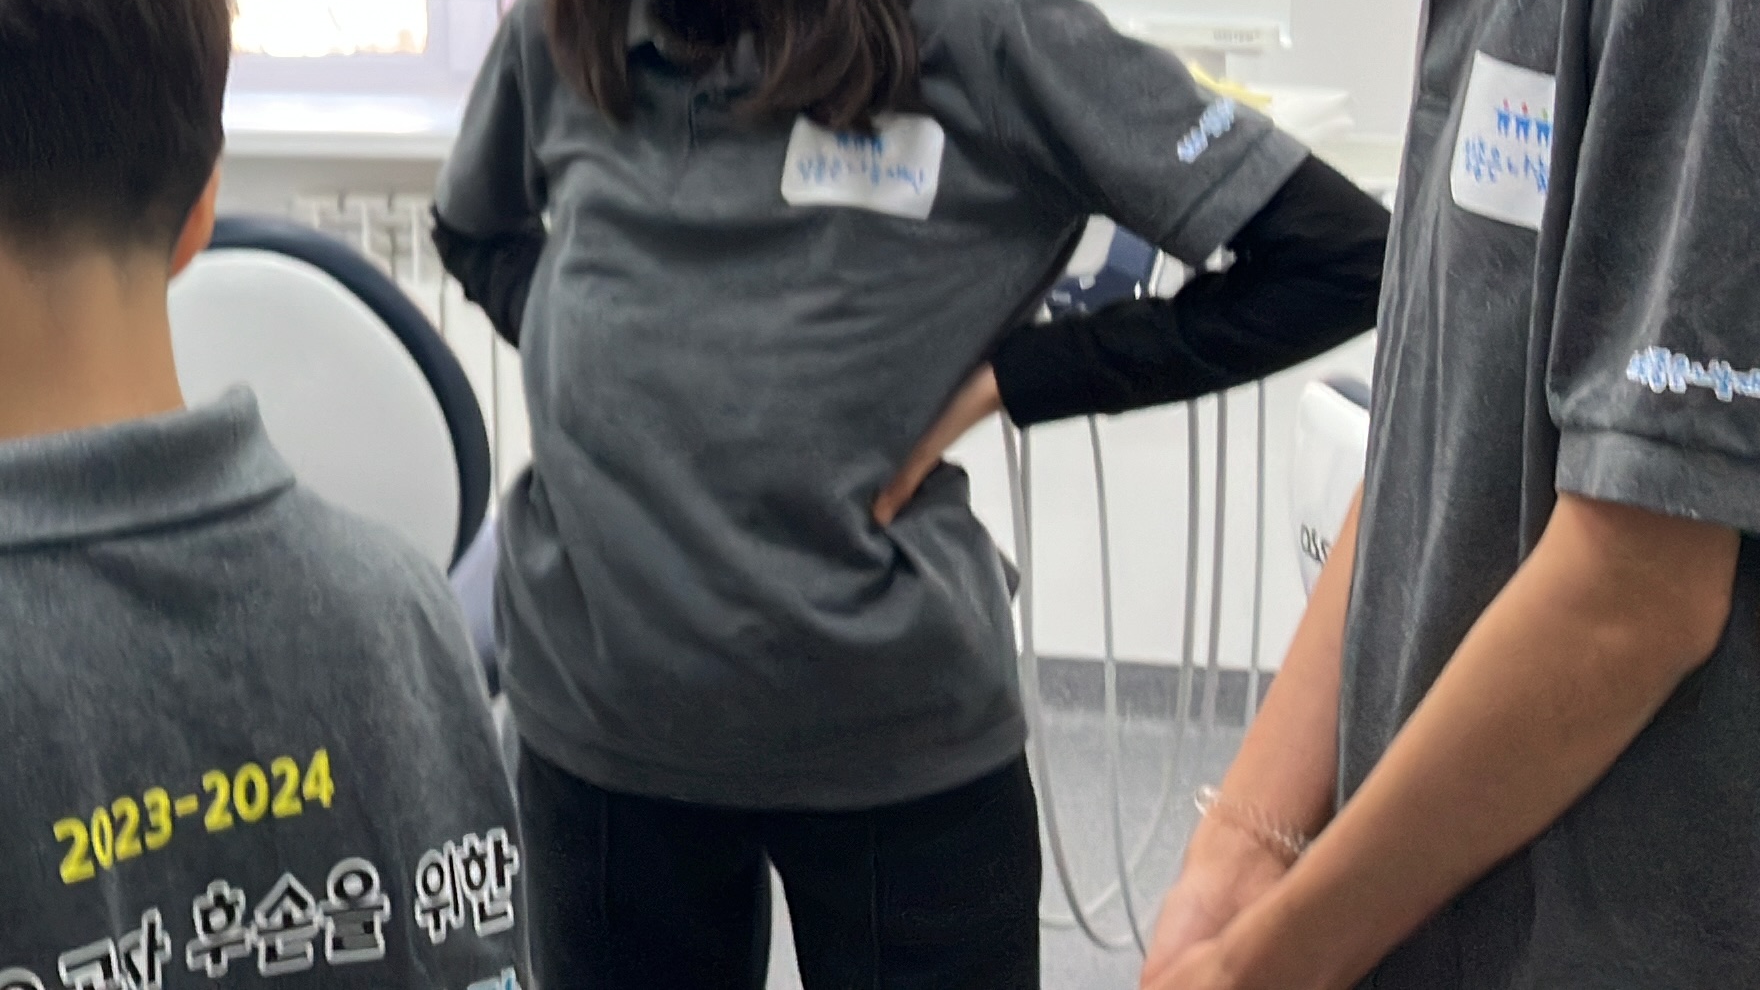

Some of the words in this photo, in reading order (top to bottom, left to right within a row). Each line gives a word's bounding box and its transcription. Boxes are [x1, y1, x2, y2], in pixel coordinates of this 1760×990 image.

[52, 748, 335, 884] 2023-2024
[186, 857, 390, 978] 후손을
[414, 827, 519, 945] 위한
